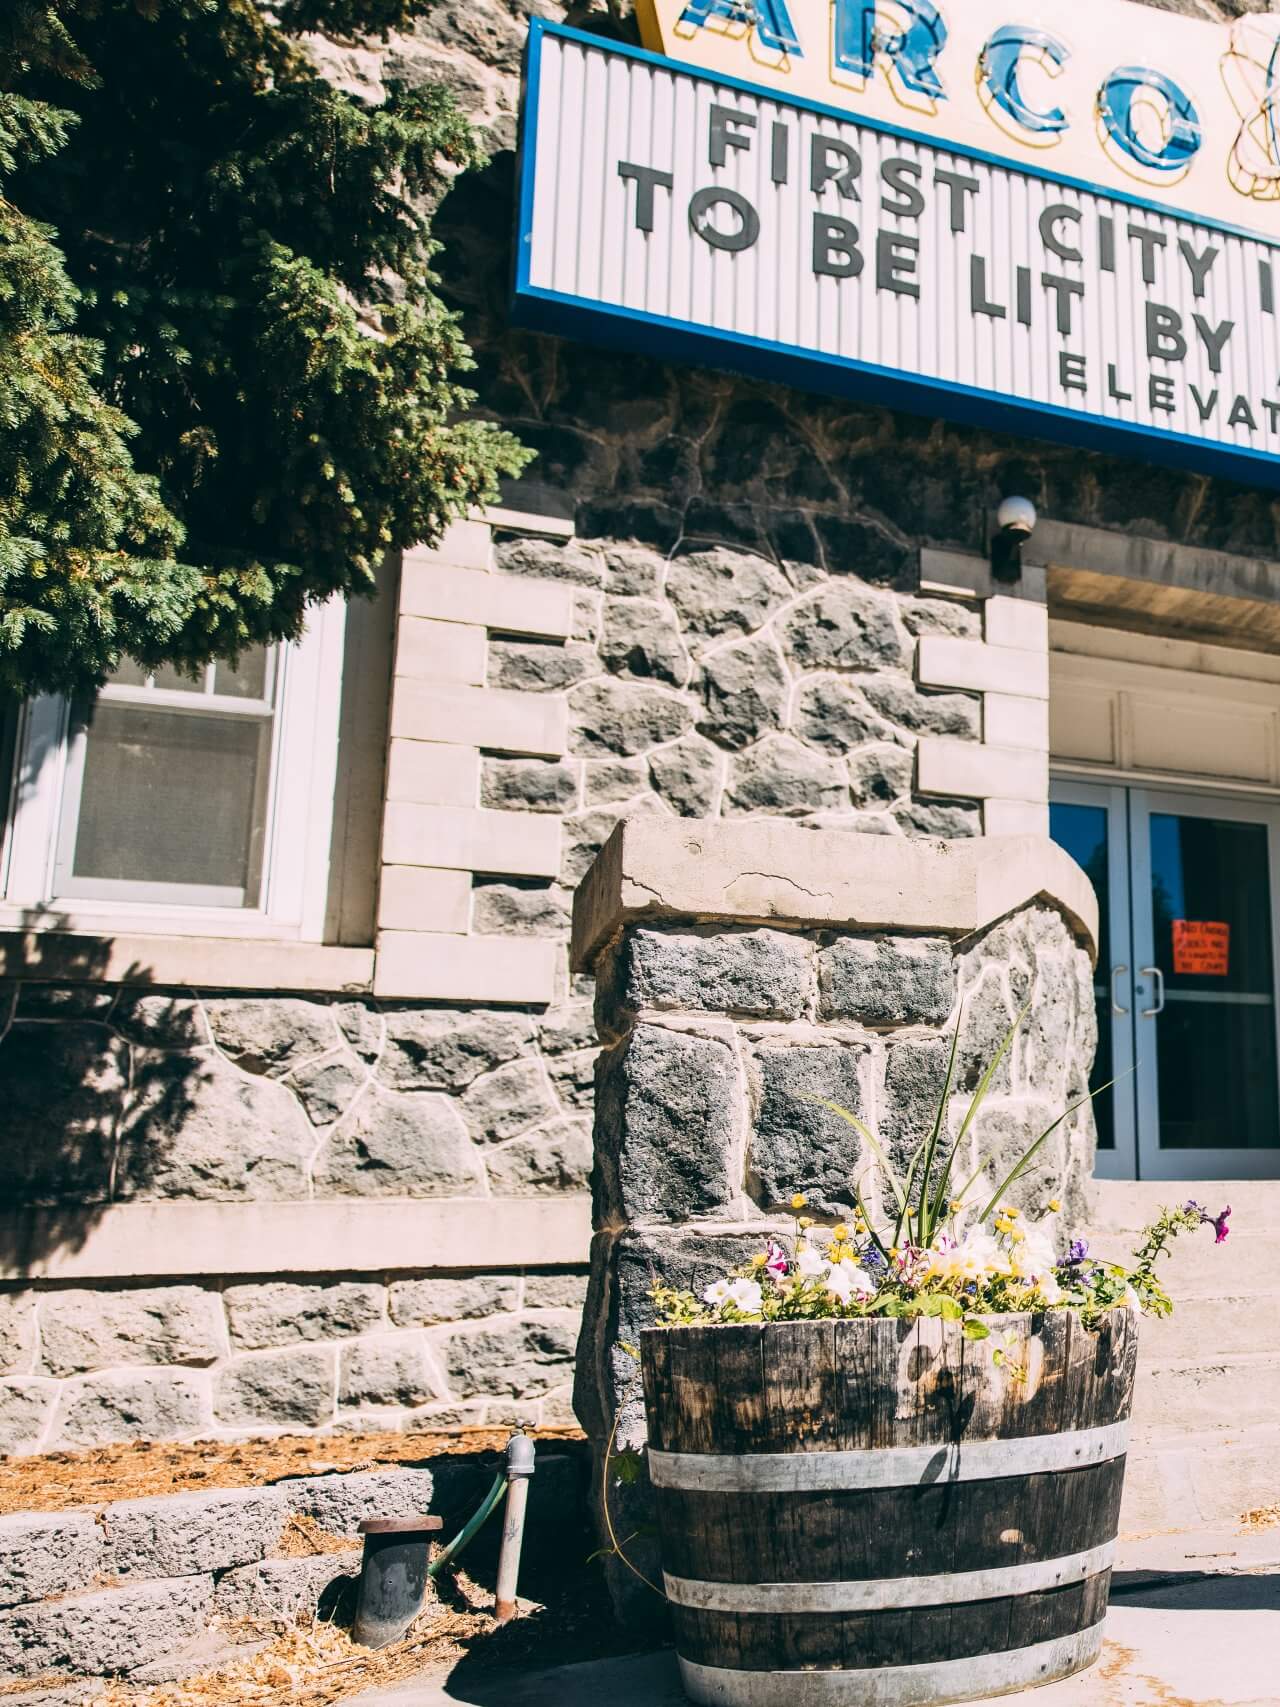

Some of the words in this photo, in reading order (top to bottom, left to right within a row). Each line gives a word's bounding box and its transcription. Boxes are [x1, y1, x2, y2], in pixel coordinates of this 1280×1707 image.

[617, 159, 761, 260] TO
[812, 211, 922, 305] BE
[970, 253, 1086, 340] LIT
[1145, 300, 1235, 377] BY
[708, 103, 980, 237] FIRST
[1038, 203, 1219, 301] CITY
